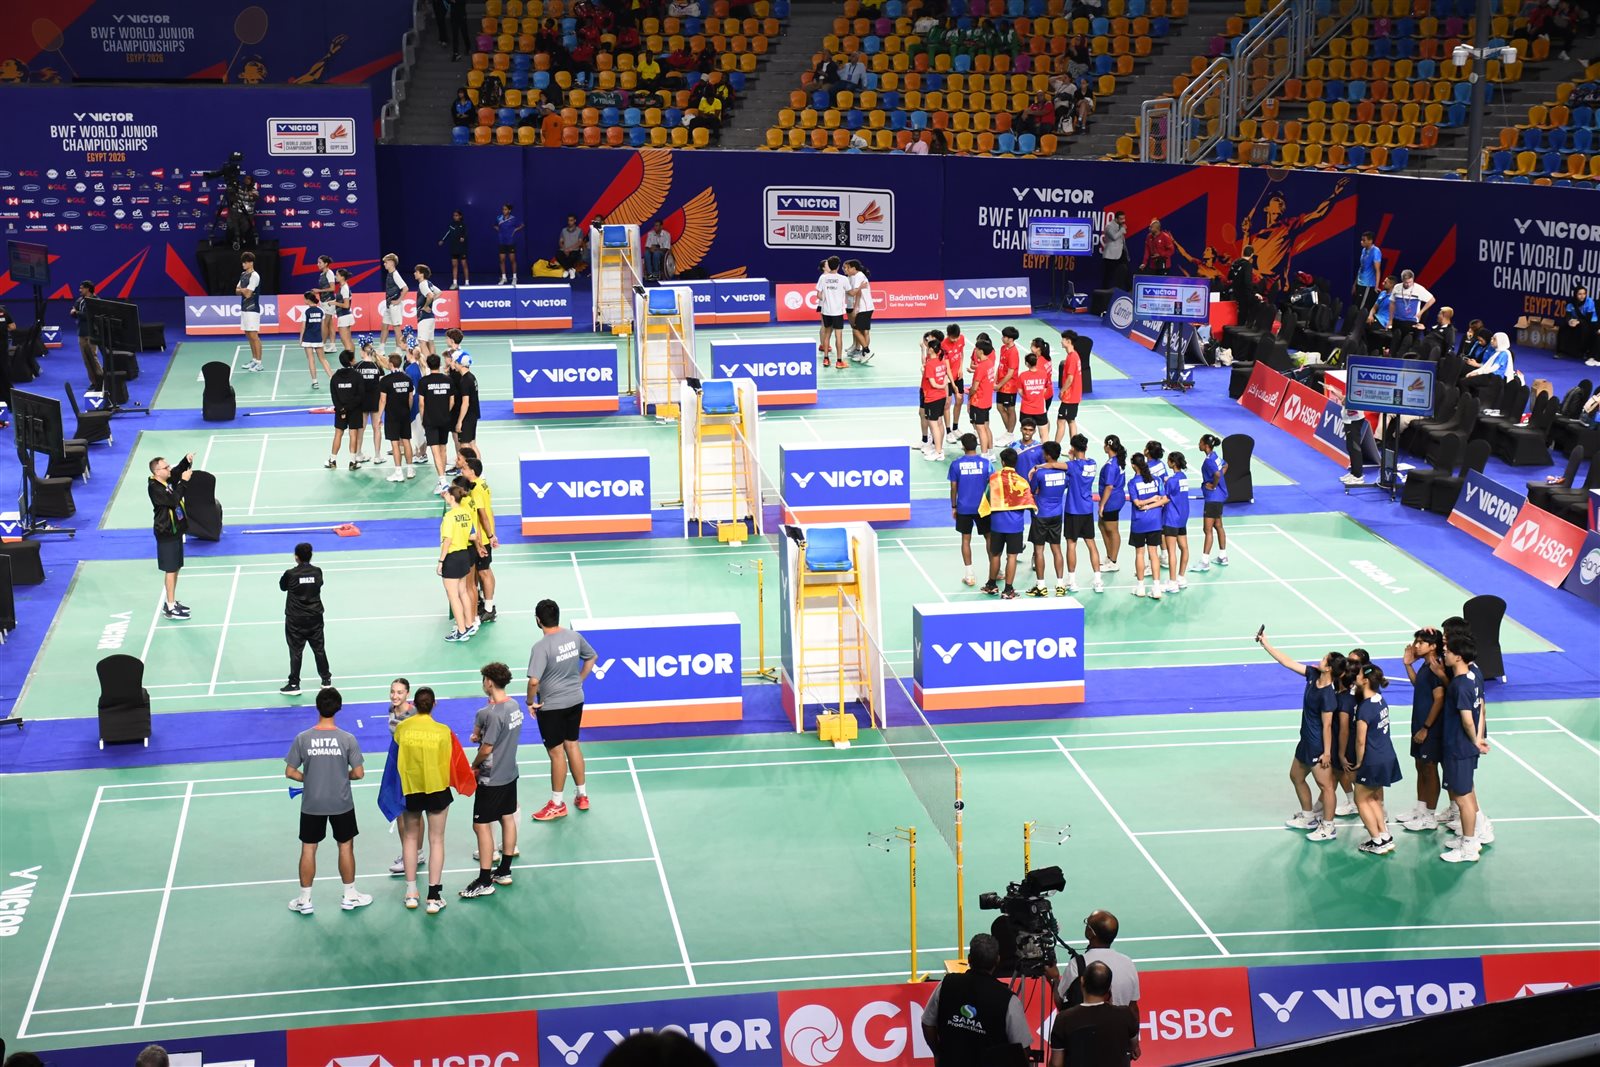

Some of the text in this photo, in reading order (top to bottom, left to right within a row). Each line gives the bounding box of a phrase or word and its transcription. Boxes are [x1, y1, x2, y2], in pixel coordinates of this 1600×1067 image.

[127, 15, 170, 23] VICTOR
[91, 27, 195, 39] BWF WORLD JUNIOR
[103, 40, 185, 52] CHAMPIONSHIPS
[126, 53, 164, 63] EGYPT 2026
[88, 113, 134, 122] VICTOR
[50, 125, 158, 138] BWF WORLD JUNIOR
[63, 138, 148, 151] CHAMPIONSHIPS
[86, 152, 126, 162] EGYPT 2026
[1033, 187, 1094, 204] VICTOR
[794, 198, 837, 209] VICTOR
[979, 206, 1014, 228] BWF
[790, 232, 833, 241] CHAMPIONSHIPS
[857, 234, 871, 242] EGYPT
[1536, 220, 1600, 242] VICTOR
[1023, 253, 1049, 269] EGYPT
[1479, 239, 1516, 264] BWF
[1520, 243, 1574, 271] WORLD
[731, 294, 766, 302] VICTOR
[889, 293, 939, 301] Badminton4U
[967, 286, 1028, 300] VICTOR
[211, 303, 276, 317] VICOR
[402, 298, 449, 318] GC
[476, 300, 511, 308] VICTOR
[532, 298, 567, 307] VICTOR
[1524, 295, 1567, 318] EGYPT 20
[1113, 302, 1132, 320] Carrier
[542, 367, 614, 383] VICTOR
[743, 361, 813, 377] VICTOR
[1369, 373, 1396, 381] VICTOR
[1299, 405, 1321, 429] HSBC
[818, 469, 904, 488] VICTOR
[558, 479, 644, 498] VICTOR
[1479, 488, 1518, 527] VICTOR
[1533, 534, 1573, 568] HSBC
[97, 620, 131, 650] VICTOR
[556, 649, 579, 663] ROMANIA
[968, 637, 1077, 662] VICTOR
[621, 652, 733, 678] VICTOR
[311, 738, 339, 748] NITA
[307, 748, 342, 756] ROMANIA
[1311, 981, 1477, 1020] VICTOR
[947, 1020, 987, 1035] Productions
[952, 1014, 983, 1030] SAMA
[1137, 1006, 1234, 1041] HSBC
[851, 1000, 936, 1062] GL
